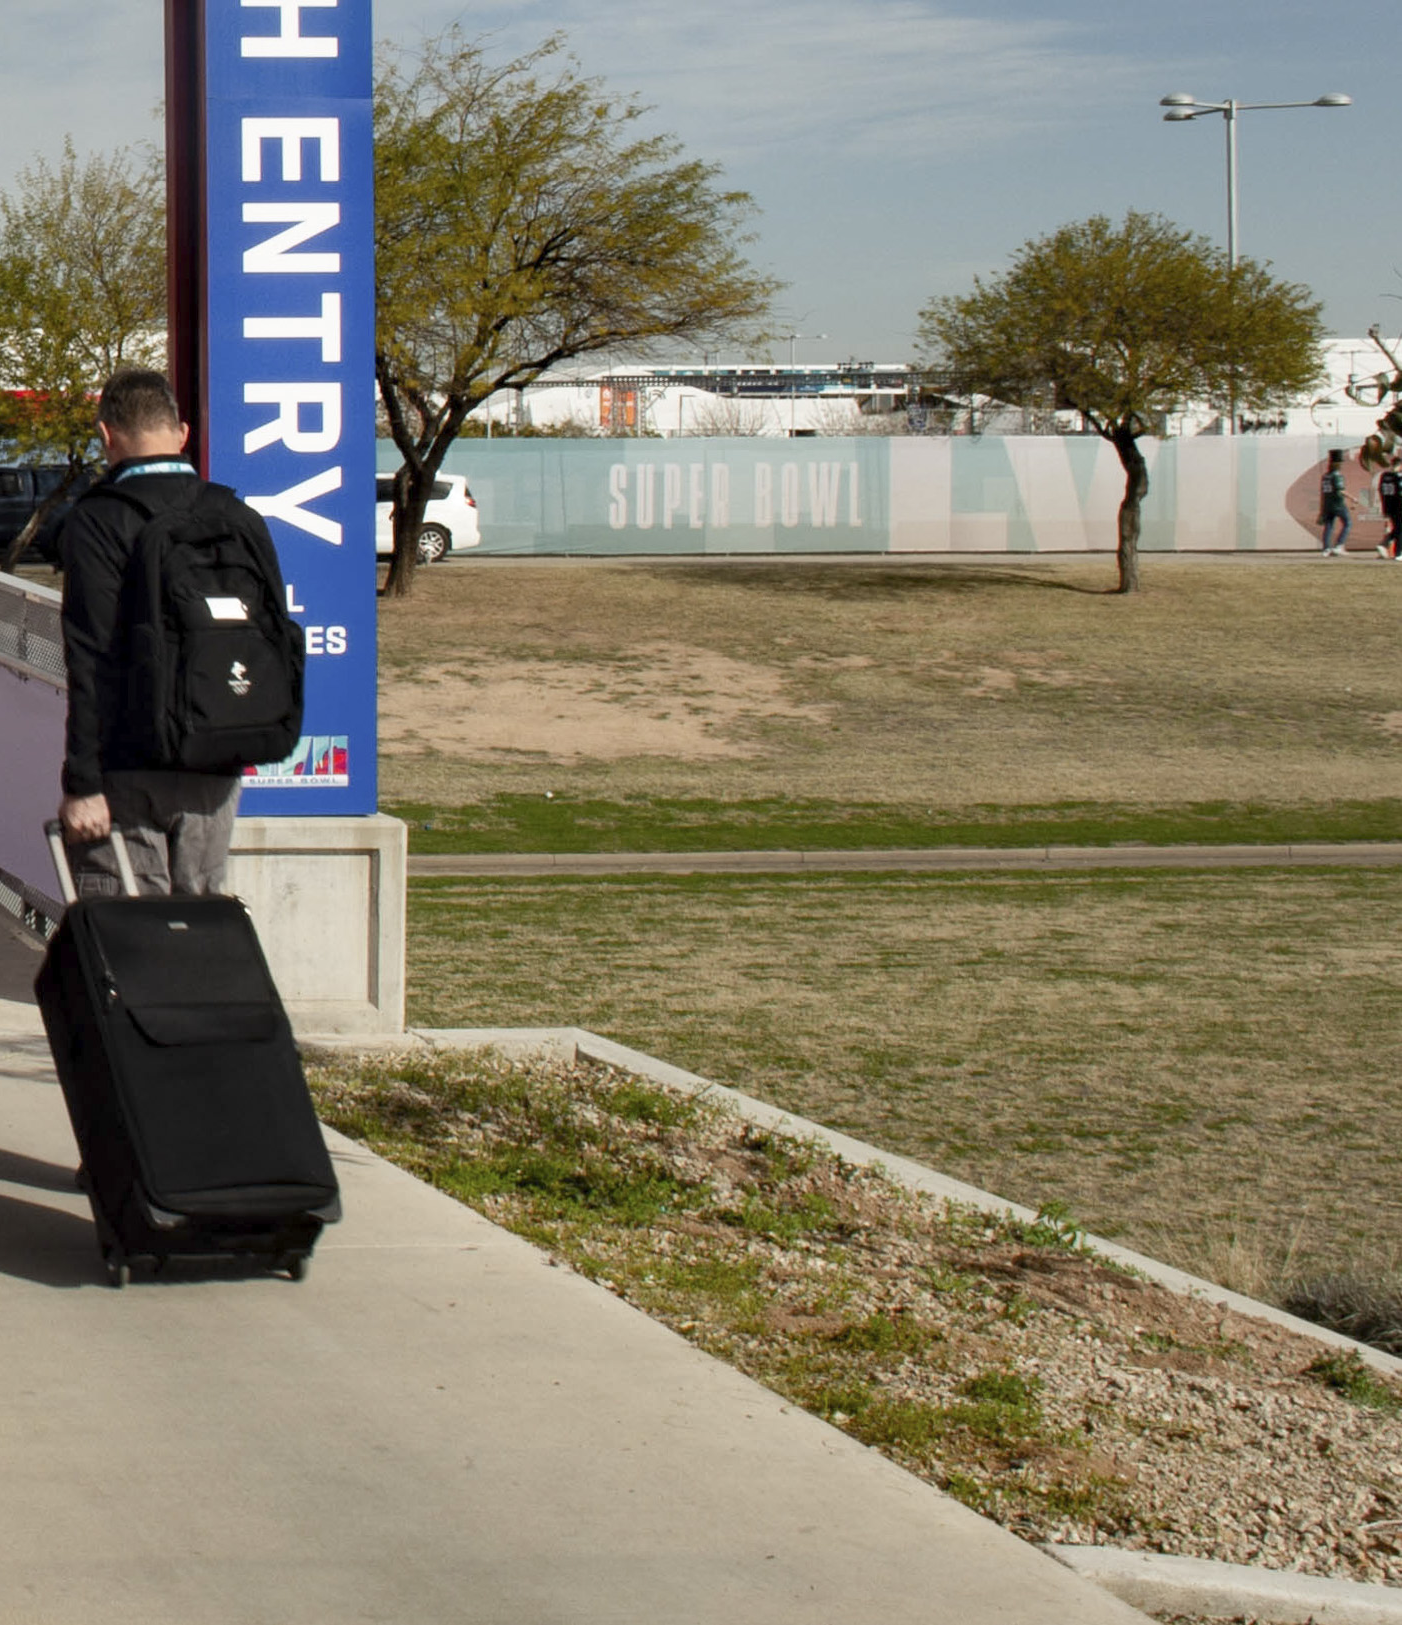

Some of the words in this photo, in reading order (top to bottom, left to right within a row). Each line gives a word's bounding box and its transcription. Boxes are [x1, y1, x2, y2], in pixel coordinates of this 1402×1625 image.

[241, 117, 343, 546] ENTRY
[609, 462, 730, 529] SUPER
[754, 462, 863, 528] BOWL
[299, 777, 338, 785] BOWL
